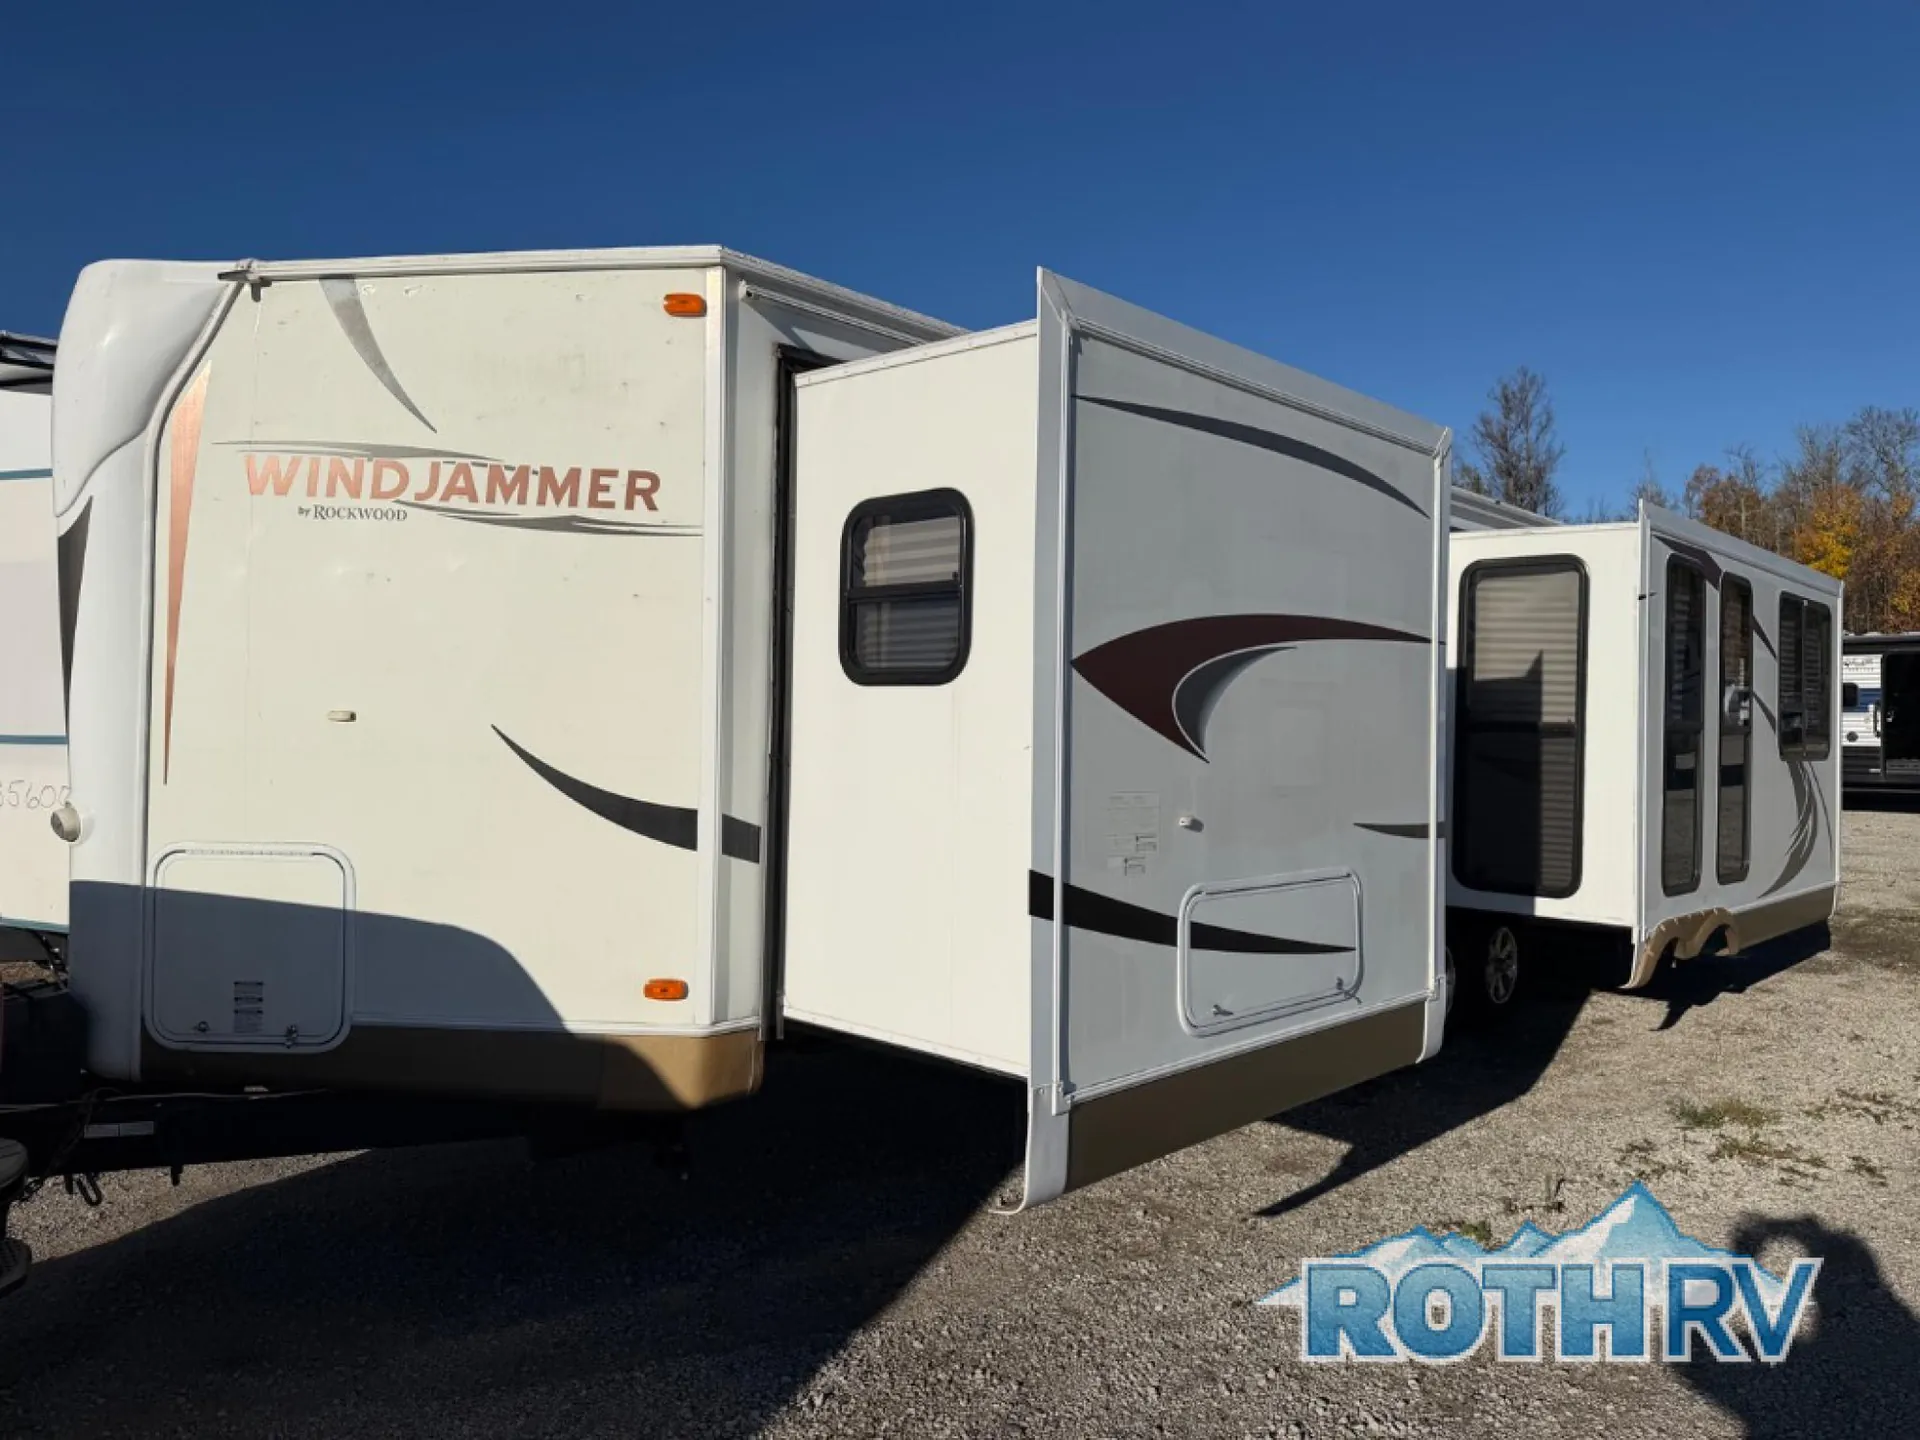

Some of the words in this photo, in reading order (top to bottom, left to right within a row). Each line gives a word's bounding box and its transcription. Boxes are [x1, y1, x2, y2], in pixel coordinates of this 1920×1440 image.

[244, 453, 662, 512] WINDJAMMER
[298, 506, 312, 517] by
[313, 504, 408, 521] ROCKWOOD
